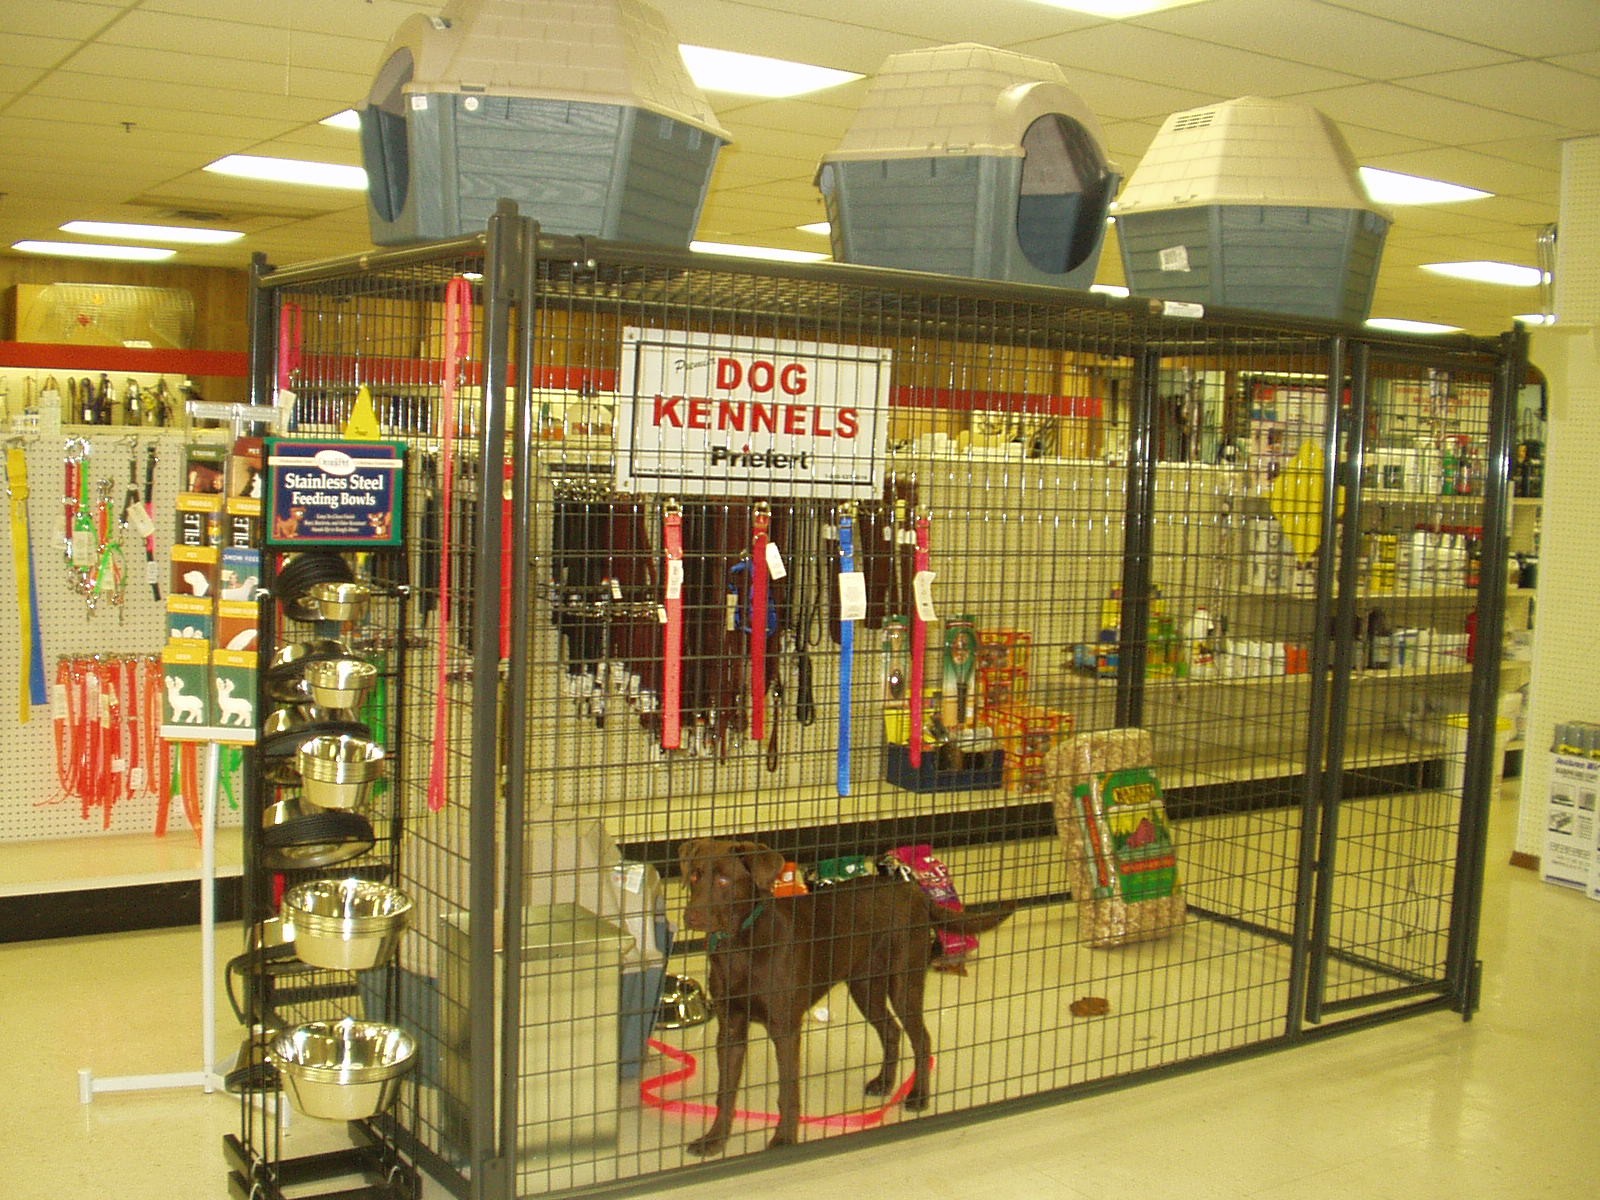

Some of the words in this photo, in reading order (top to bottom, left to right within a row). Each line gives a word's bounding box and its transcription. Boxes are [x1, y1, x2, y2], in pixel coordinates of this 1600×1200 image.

[716, 357, 808, 395] DOG
[653, 394, 860, 439] KENNELS
[711, 444, 809, 469] Priefert
[285, 472, 348, 490] Stainless
[349, 474, 384, 490] Steel
[292, 492, 339, 509] Feeding
[341, 492, 376, 506] Bowls
[184, 513, 200, 545] FILE
[233, 517, 250, 549] FILE
